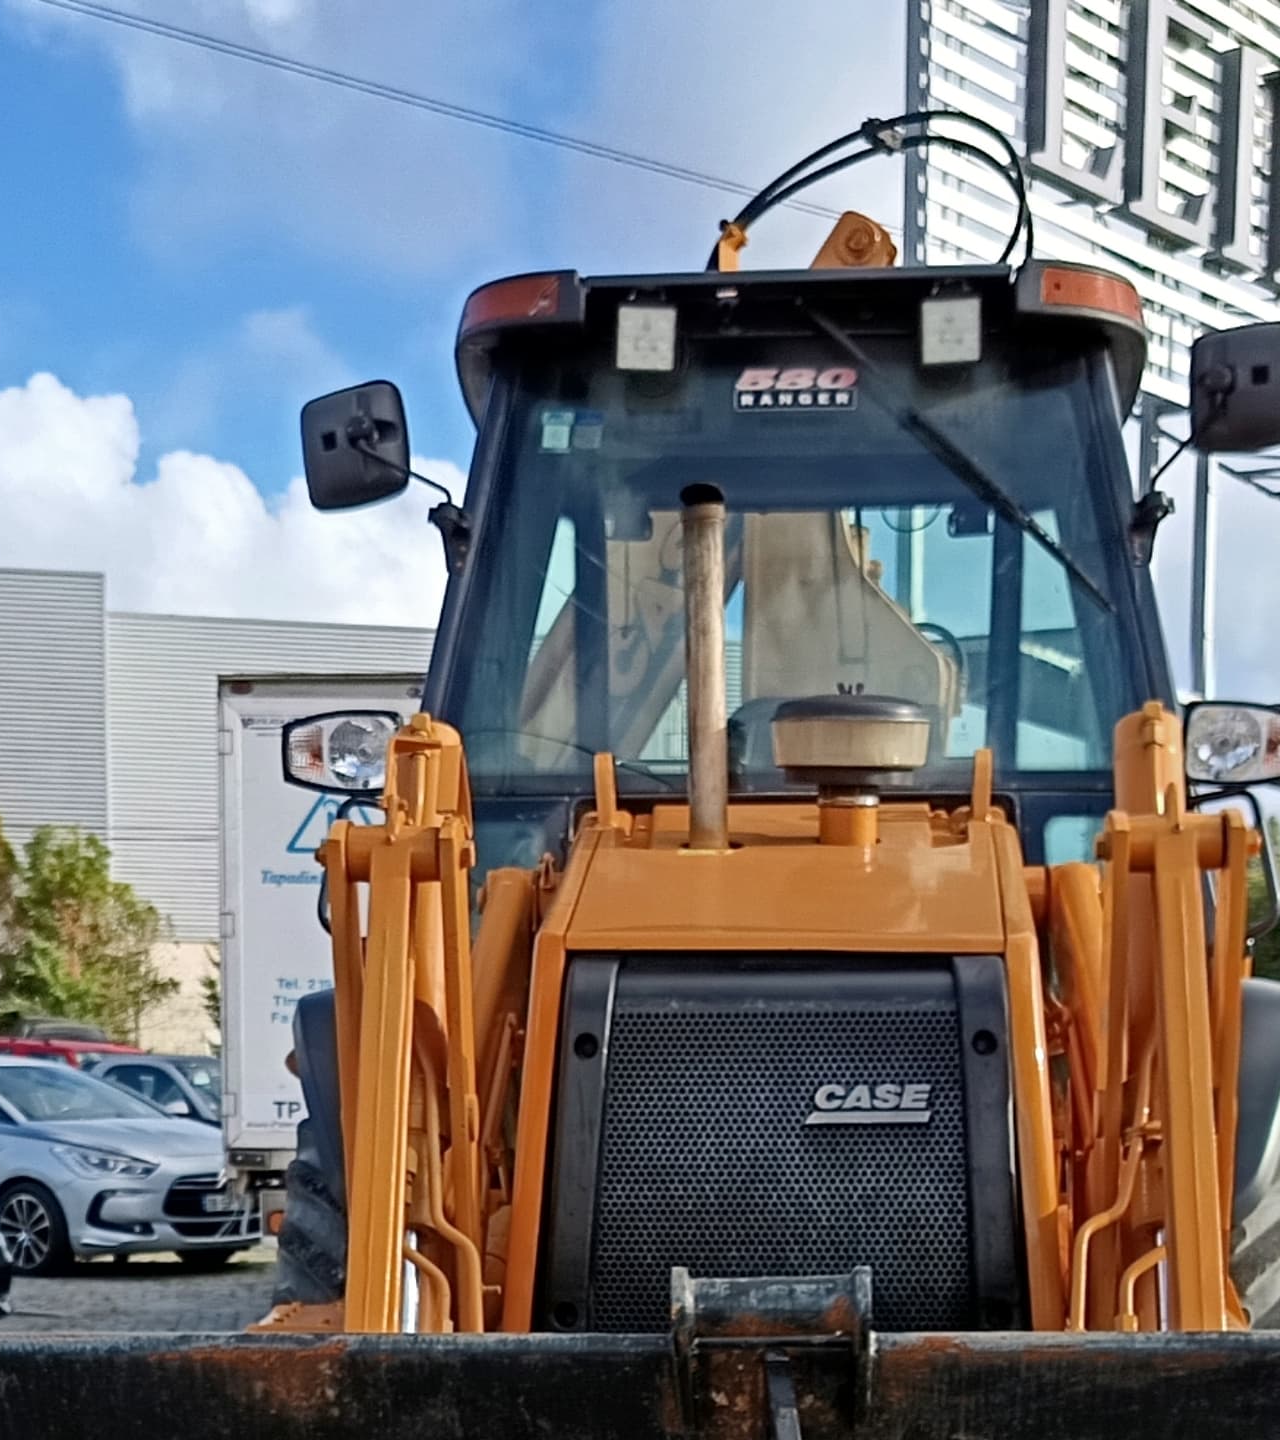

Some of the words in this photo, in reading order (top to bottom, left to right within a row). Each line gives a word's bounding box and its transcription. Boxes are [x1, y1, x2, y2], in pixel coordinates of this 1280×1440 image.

[735, 367, 857, 391] 580
[740, 392, 850, 406] RANGER
[814, 1084, 932, 1110] CASE
